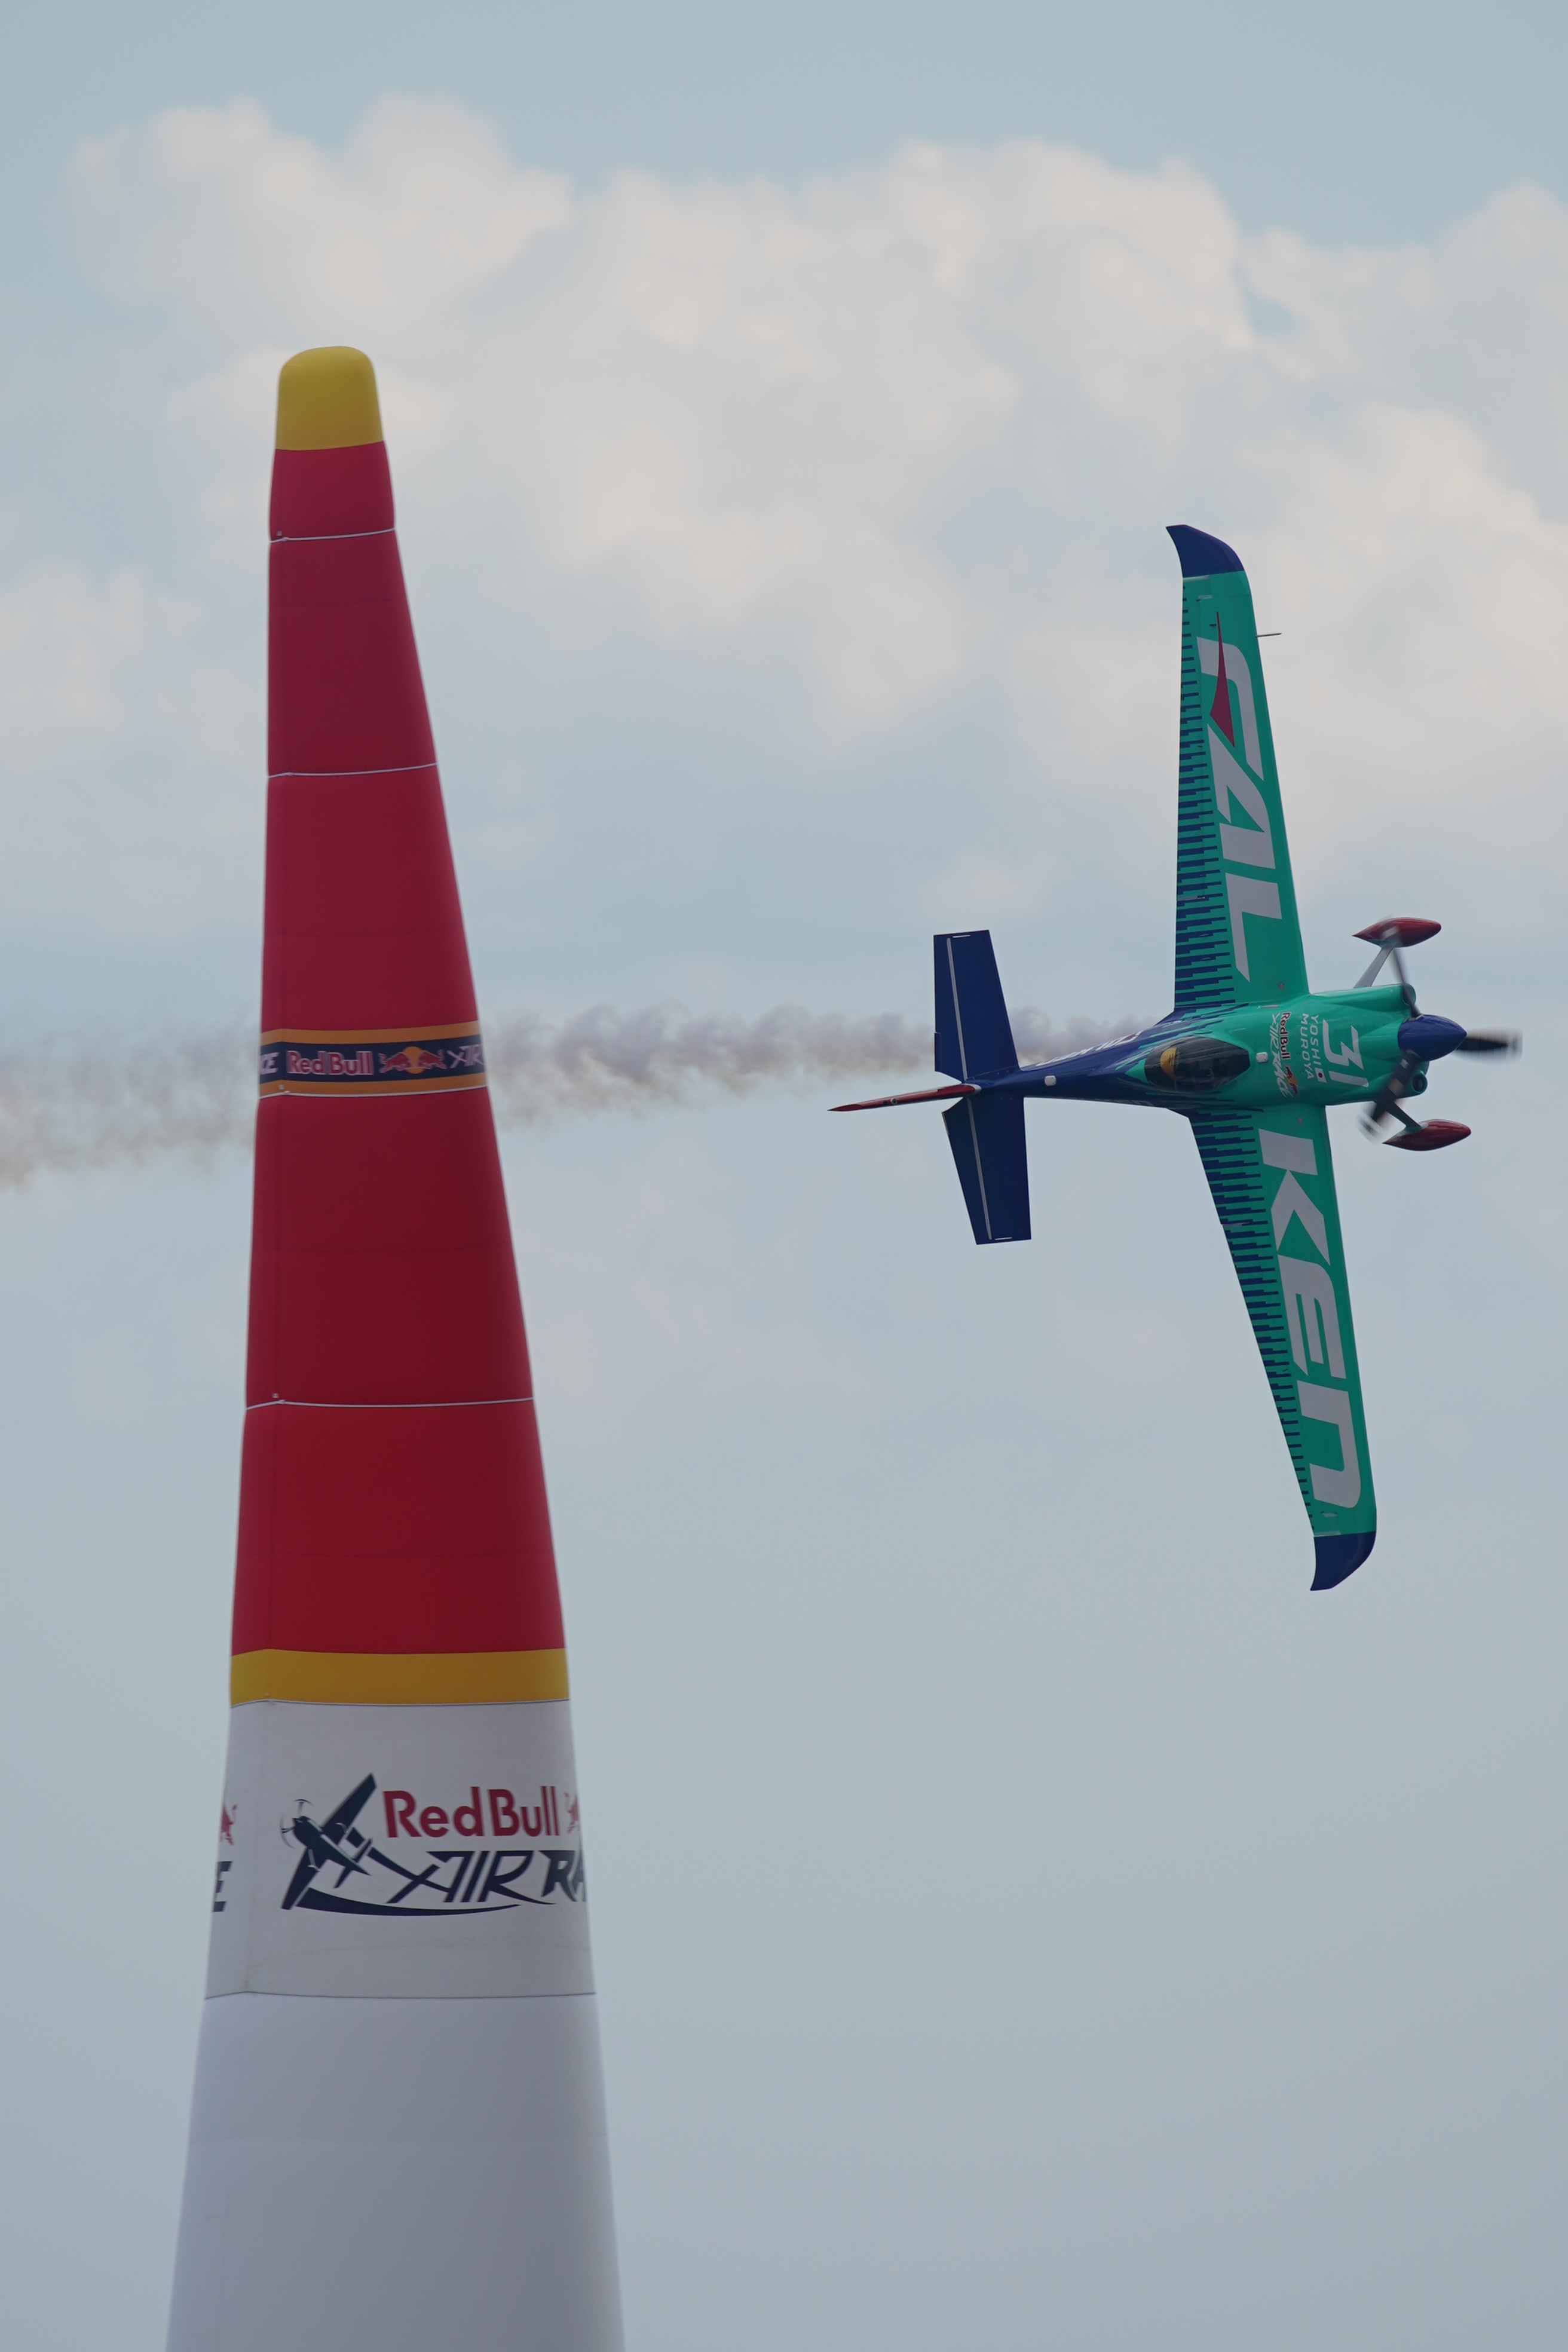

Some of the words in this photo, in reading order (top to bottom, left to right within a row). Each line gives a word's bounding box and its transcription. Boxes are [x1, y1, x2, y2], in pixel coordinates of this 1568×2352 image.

[1280, 1011, 1291, 1035] Red
[1280, 1035, 1291, 1060] Bull
[1300, 1013, 1314, 1079] MUROYA
[1310, 1014, 1322, 1065] YOSHI
[286, 1050, 326, 1075] Red
[327, 1051, 373, 1076] Bull
[1197, 612, 1283, 983] FAL
[1258, 1128, 1361, 1509] KEN
[1272, 1050, 1294, 1098] RACE
[1322, 1018, 1369, 1088] 31
[383, 1786, 485, 1838] Red
[487, 1786, 560, 1838] Bull
